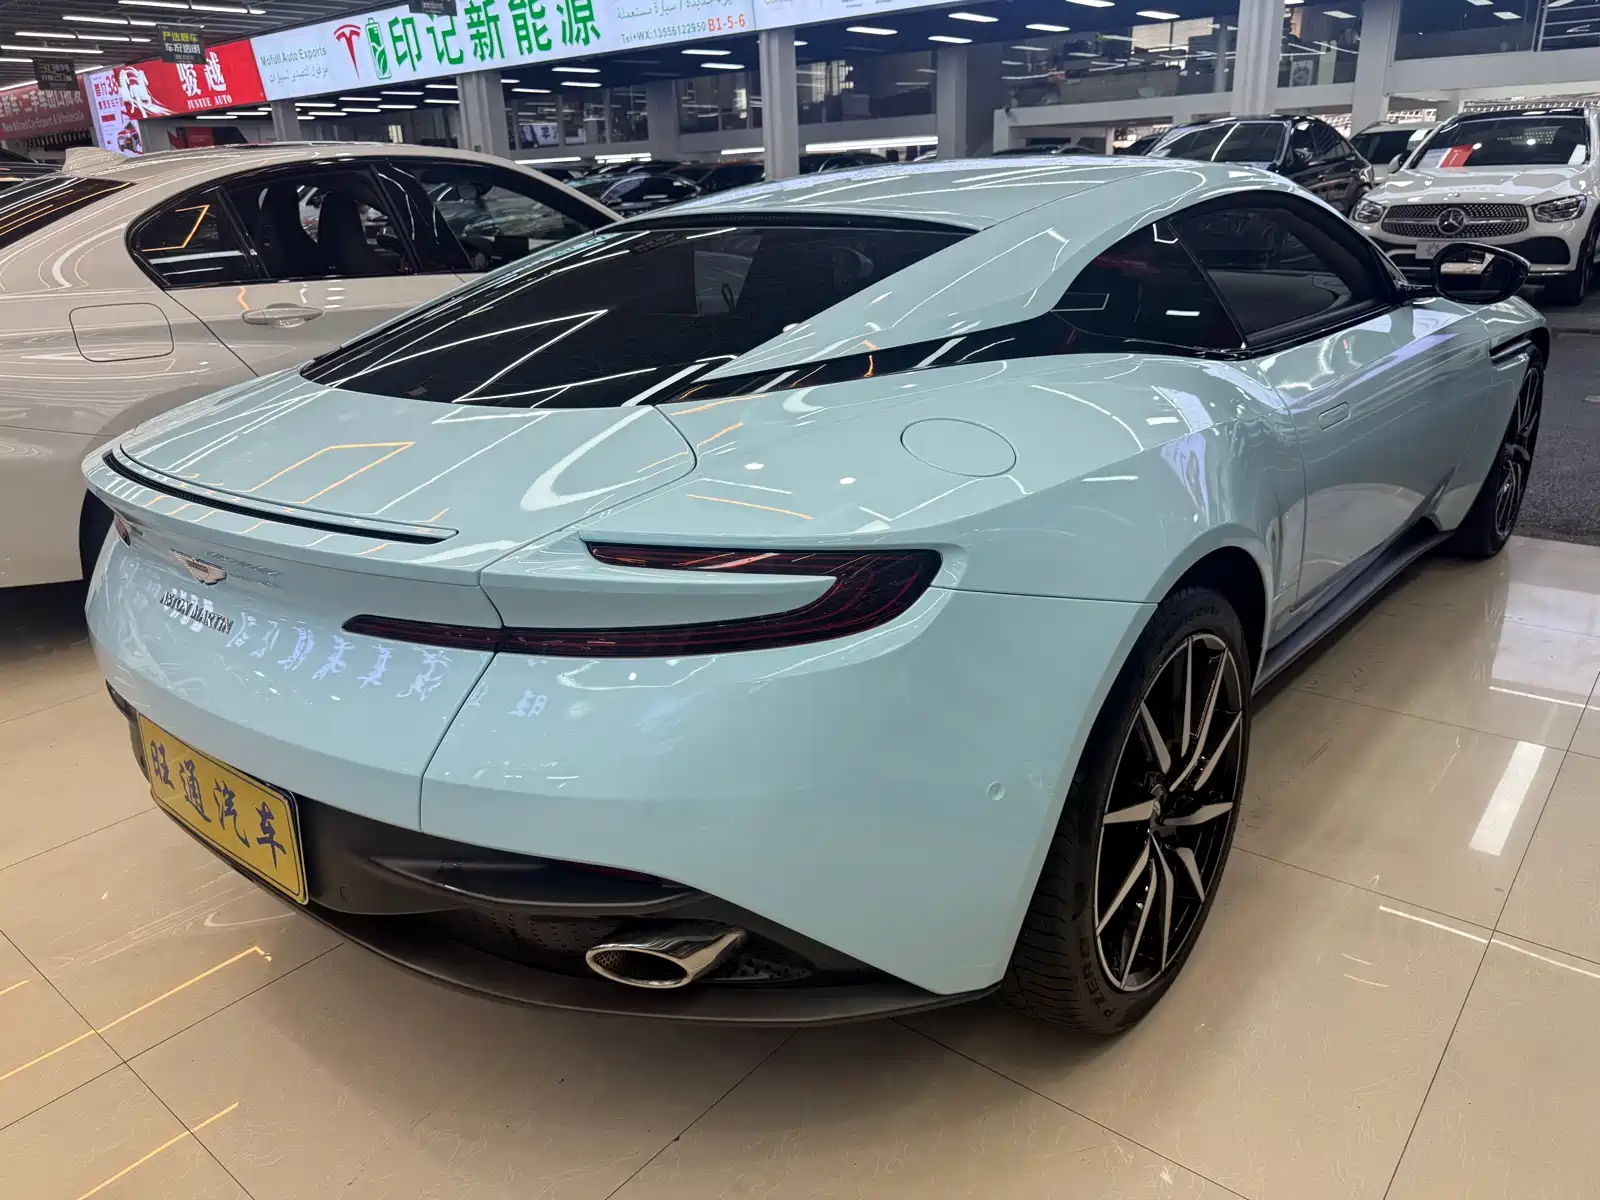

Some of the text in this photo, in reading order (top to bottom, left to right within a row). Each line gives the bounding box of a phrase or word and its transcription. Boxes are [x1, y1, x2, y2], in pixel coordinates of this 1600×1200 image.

[388, 0, 600, 72] 印记新能源
[707, 13, 745, 32] B1-5-6
[176, 51, 227, 97] 骏越
[282, 52, 299, 63] Auto
[298, 47, 327, 61] Exports
[213, 93, 234, 106] AUTO
[160, 590, 234, 635] ASTON MARTIN
[150, 739, 287, 871] 旺通汽车
